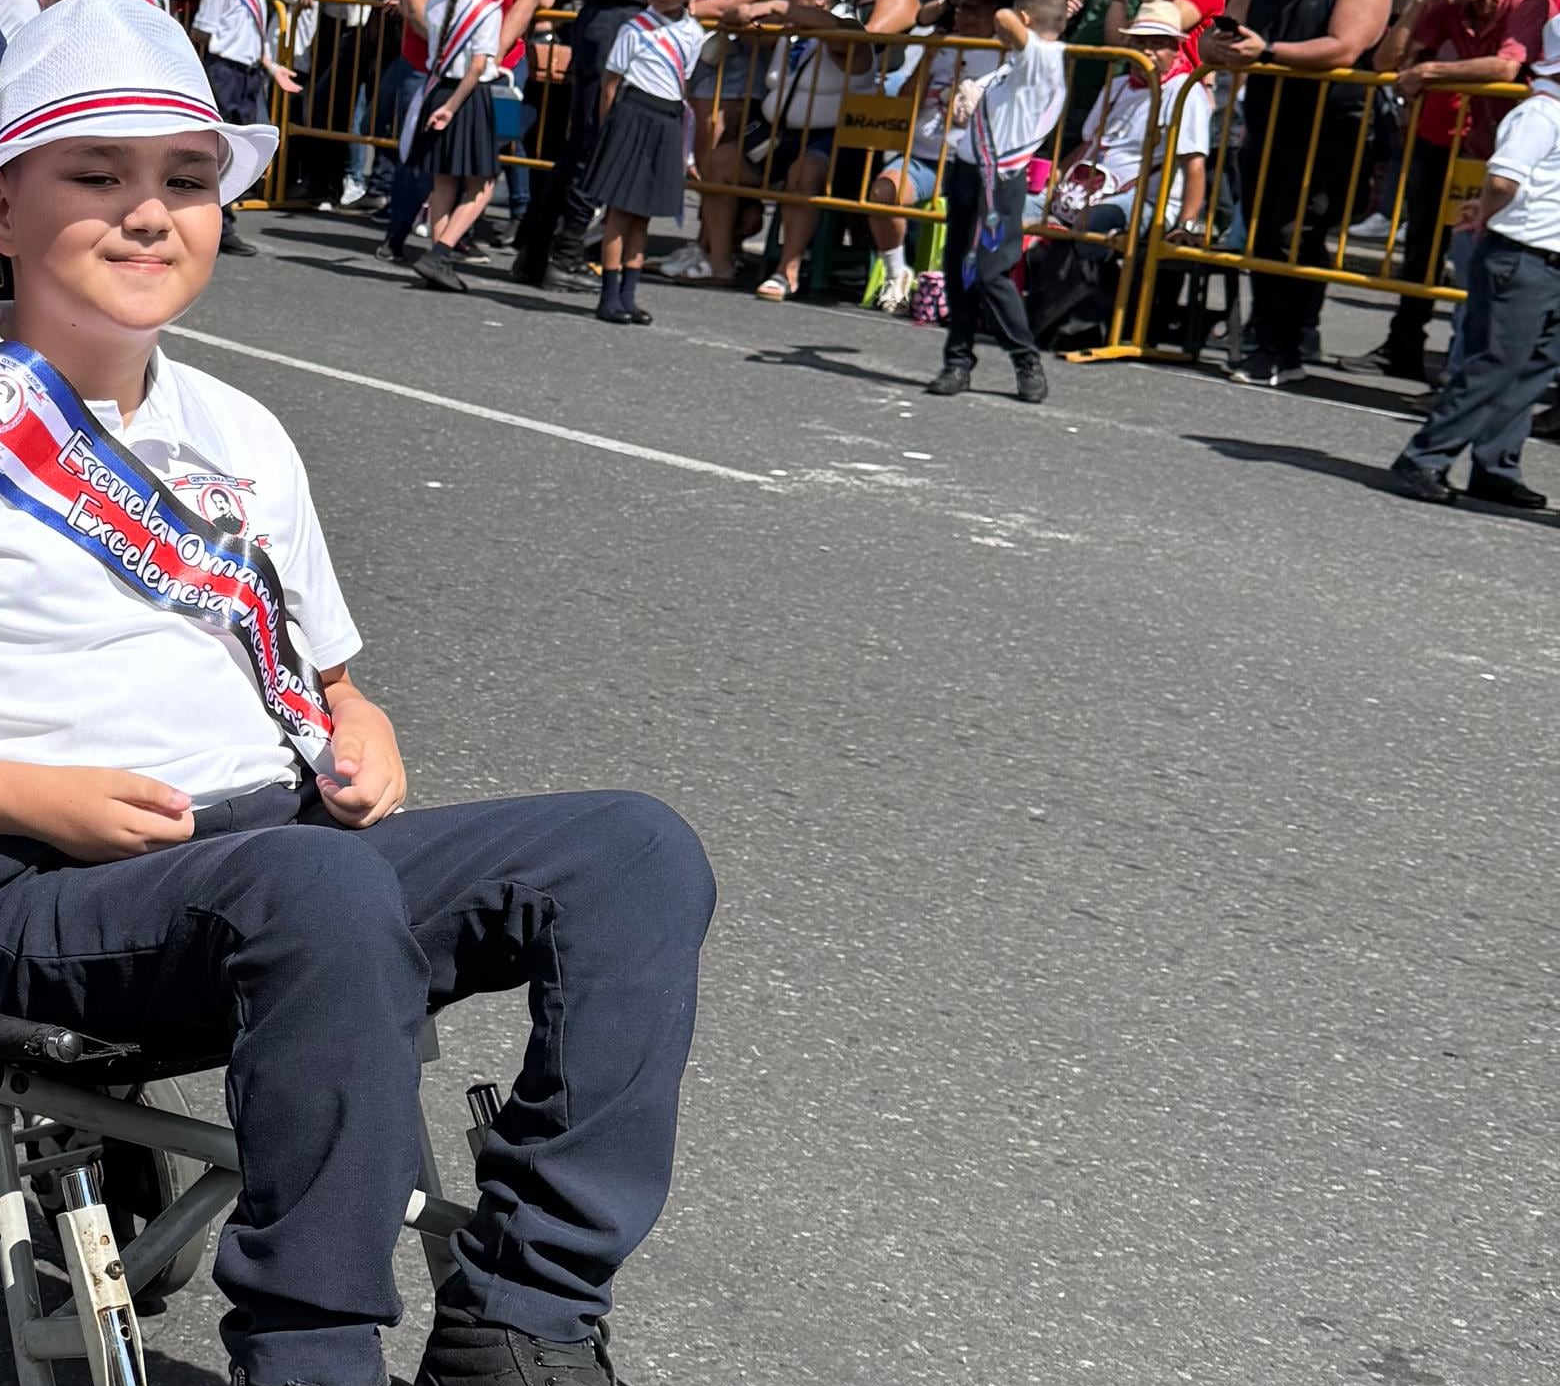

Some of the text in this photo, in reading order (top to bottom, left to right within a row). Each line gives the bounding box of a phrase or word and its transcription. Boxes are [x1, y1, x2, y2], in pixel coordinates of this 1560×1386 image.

[56, 426, 172, 547] Escuela
[175, 532, 272, 609] Omar
[65, 490, 235, 616] Excelencia
